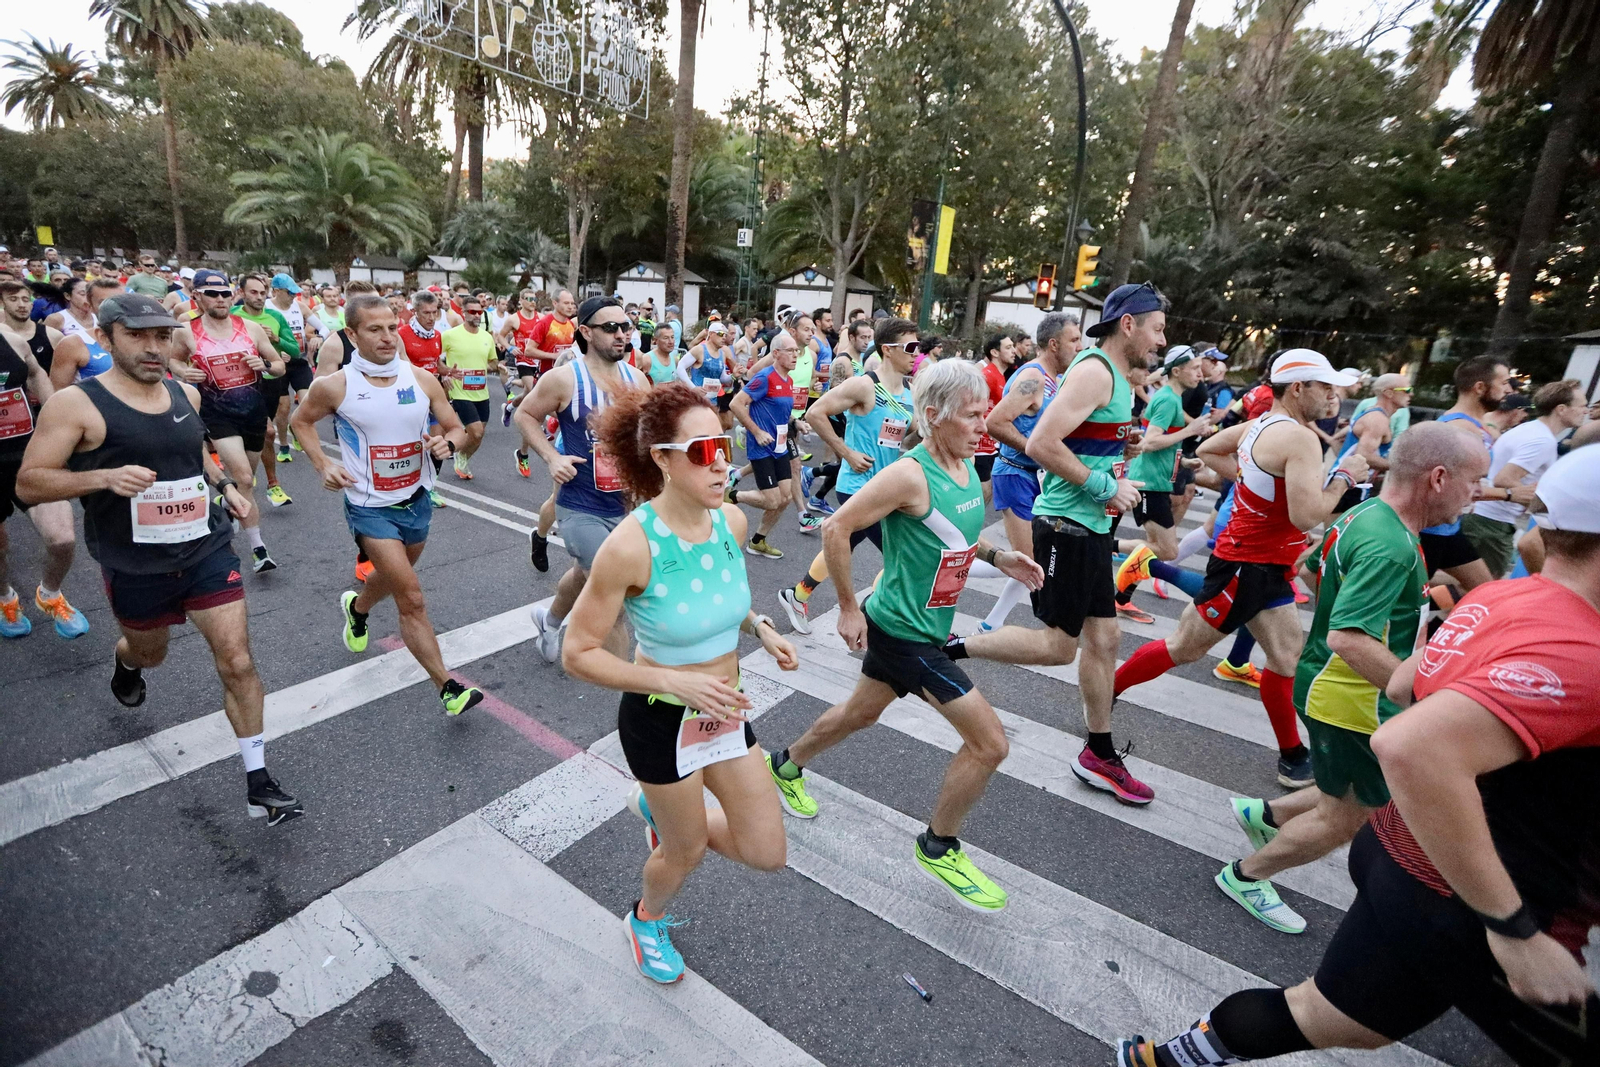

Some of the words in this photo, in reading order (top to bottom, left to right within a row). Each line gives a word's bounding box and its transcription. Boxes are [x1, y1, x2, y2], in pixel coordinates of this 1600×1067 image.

[598, 66, 630, 105] FUN
[225, 364, 240, 372] 573
[388, 459, 411, 470] 4729
[156, 501, 196, 516] 10196
[955, 497, 981, 514] TOTLEY
[1047, 552, 1057, 578] TERREX
[698, 720, 722, 732] 103
[1172, 1044, 1190, 1066] DAY
